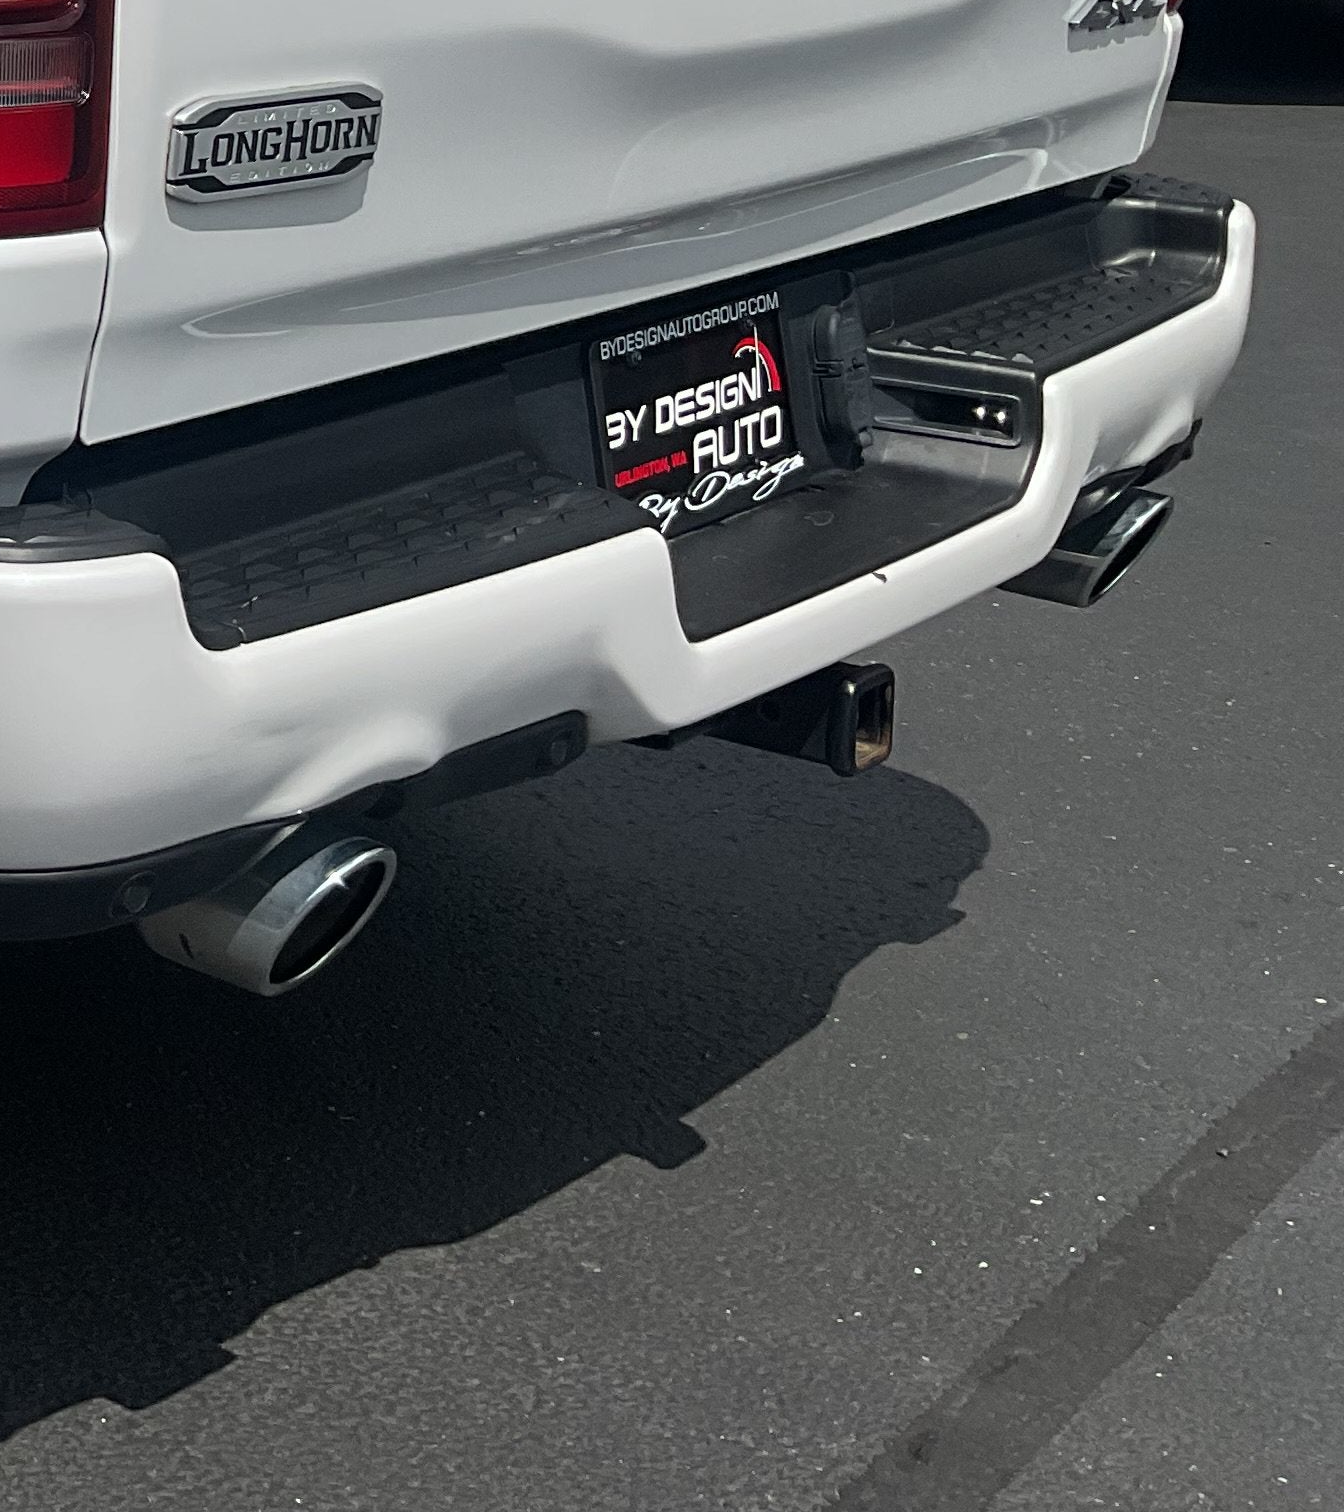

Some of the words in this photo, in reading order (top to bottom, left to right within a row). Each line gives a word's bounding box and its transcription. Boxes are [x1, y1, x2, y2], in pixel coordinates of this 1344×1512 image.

[238, 103, 338, 126] LIMITED
[228, 161, 332, 183] EDITION
[599, 291, 780, 361] BYDESIGNAUTOGROUP.COM
[605, 404, 647, 450] BY
[655, 366, 762, 434] DESIGN
[692, 405, 782, 474] AUTO
